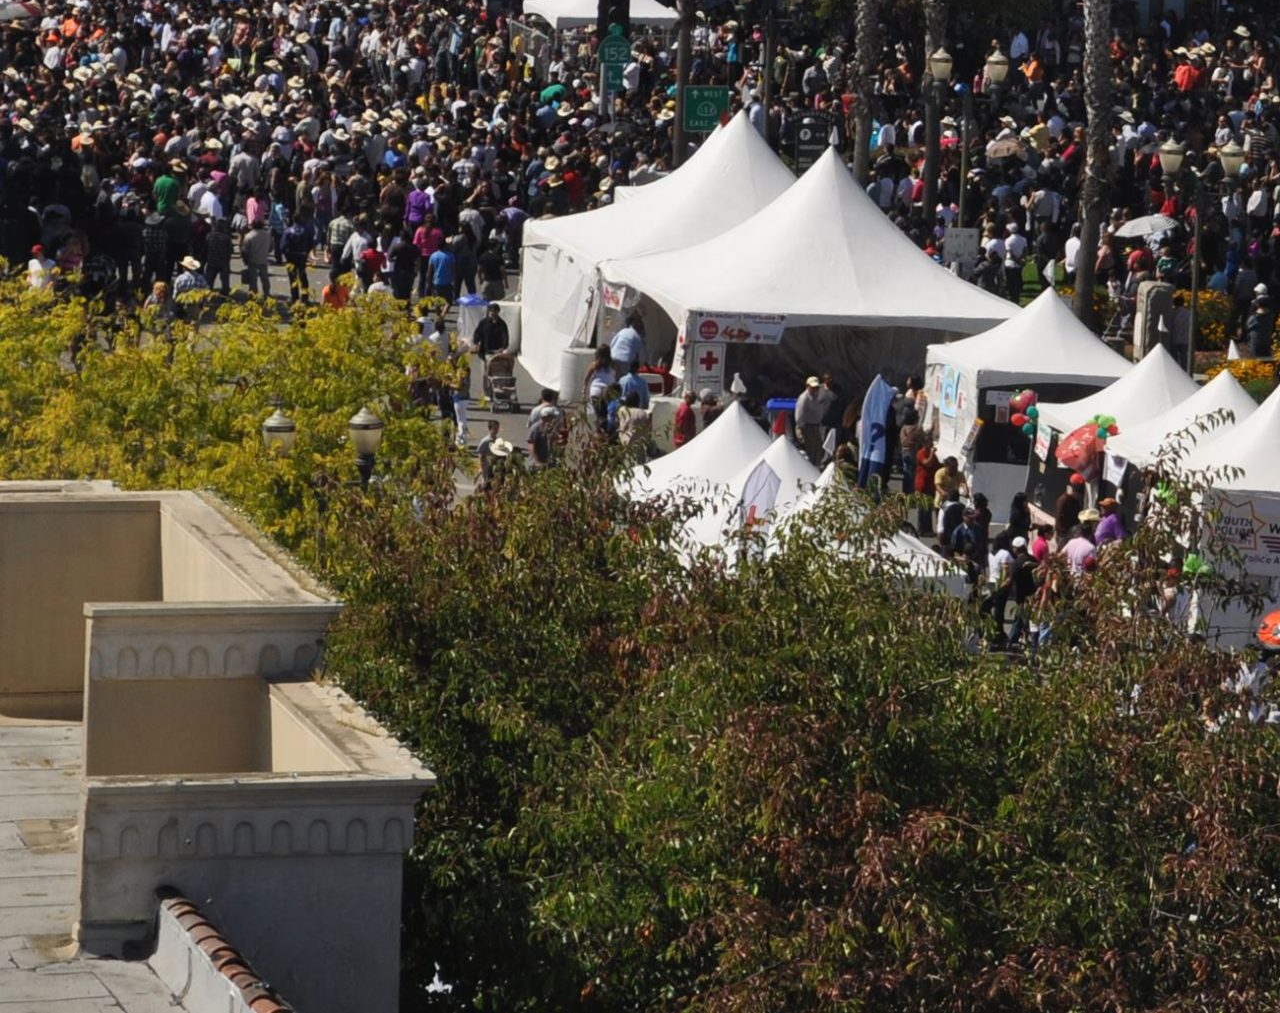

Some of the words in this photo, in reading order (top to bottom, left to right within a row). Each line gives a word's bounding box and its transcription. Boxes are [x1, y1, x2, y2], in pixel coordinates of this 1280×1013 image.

[604, 48, 628, 62] 152
[703, 90, 723, 98] WEST
[689, 119, 709, 127] EAST
